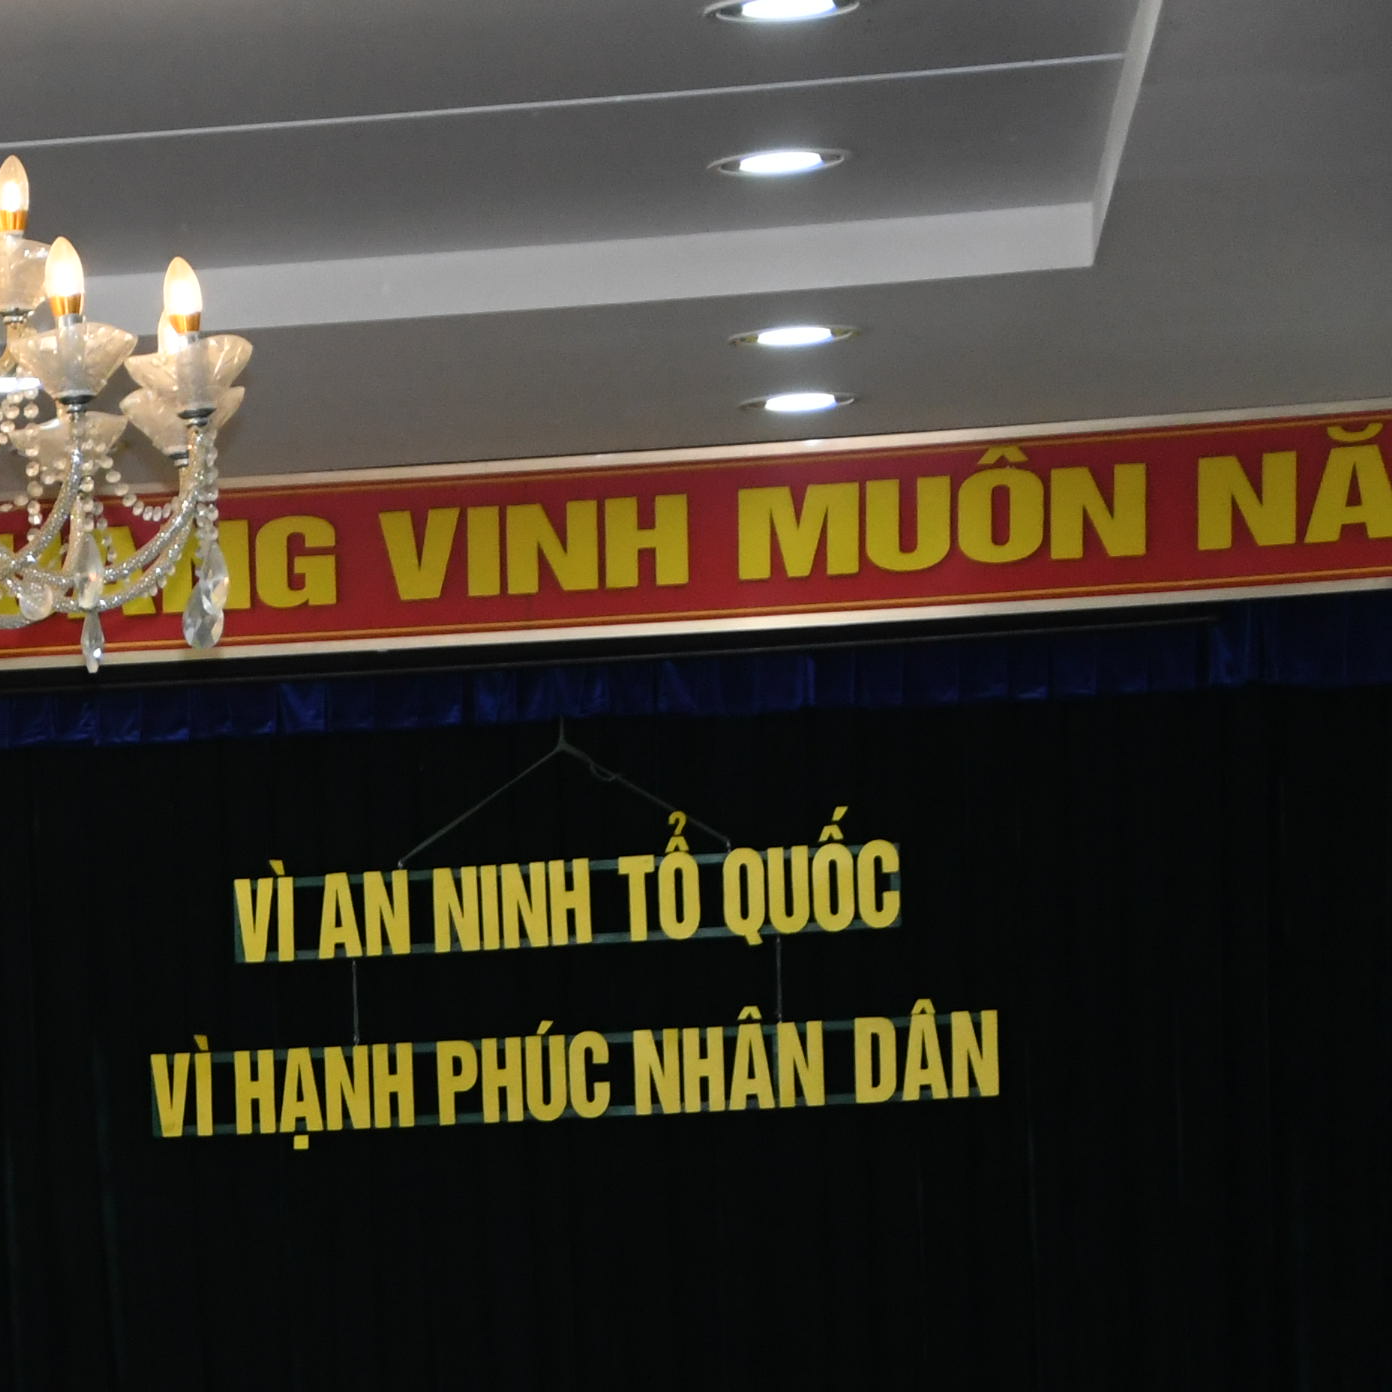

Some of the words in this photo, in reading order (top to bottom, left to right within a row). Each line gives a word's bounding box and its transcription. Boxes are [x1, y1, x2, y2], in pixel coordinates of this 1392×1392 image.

[380, 494, 688, 601] VINH
[738, 446, 1146, 581] MUÔN
[1198, 422, 1392, 550] NĂ
[235, 860, 295, 963] VÌ
[318, 870, 411, 960] AN
[433, 858, 593, 953] NINH
[618, 811, 701, 942] TỔ
[723, 806, 901, 946] QUỐC
[151, 1035, 213, 1138] VÌ
[234, 1042, 415, 1150] HẠNH
[437, 1020, 611, 1126] PHÚC
[634, 1006, 825, 1116] NHÂN
[855, 998, 1000, 1104] DÂN
